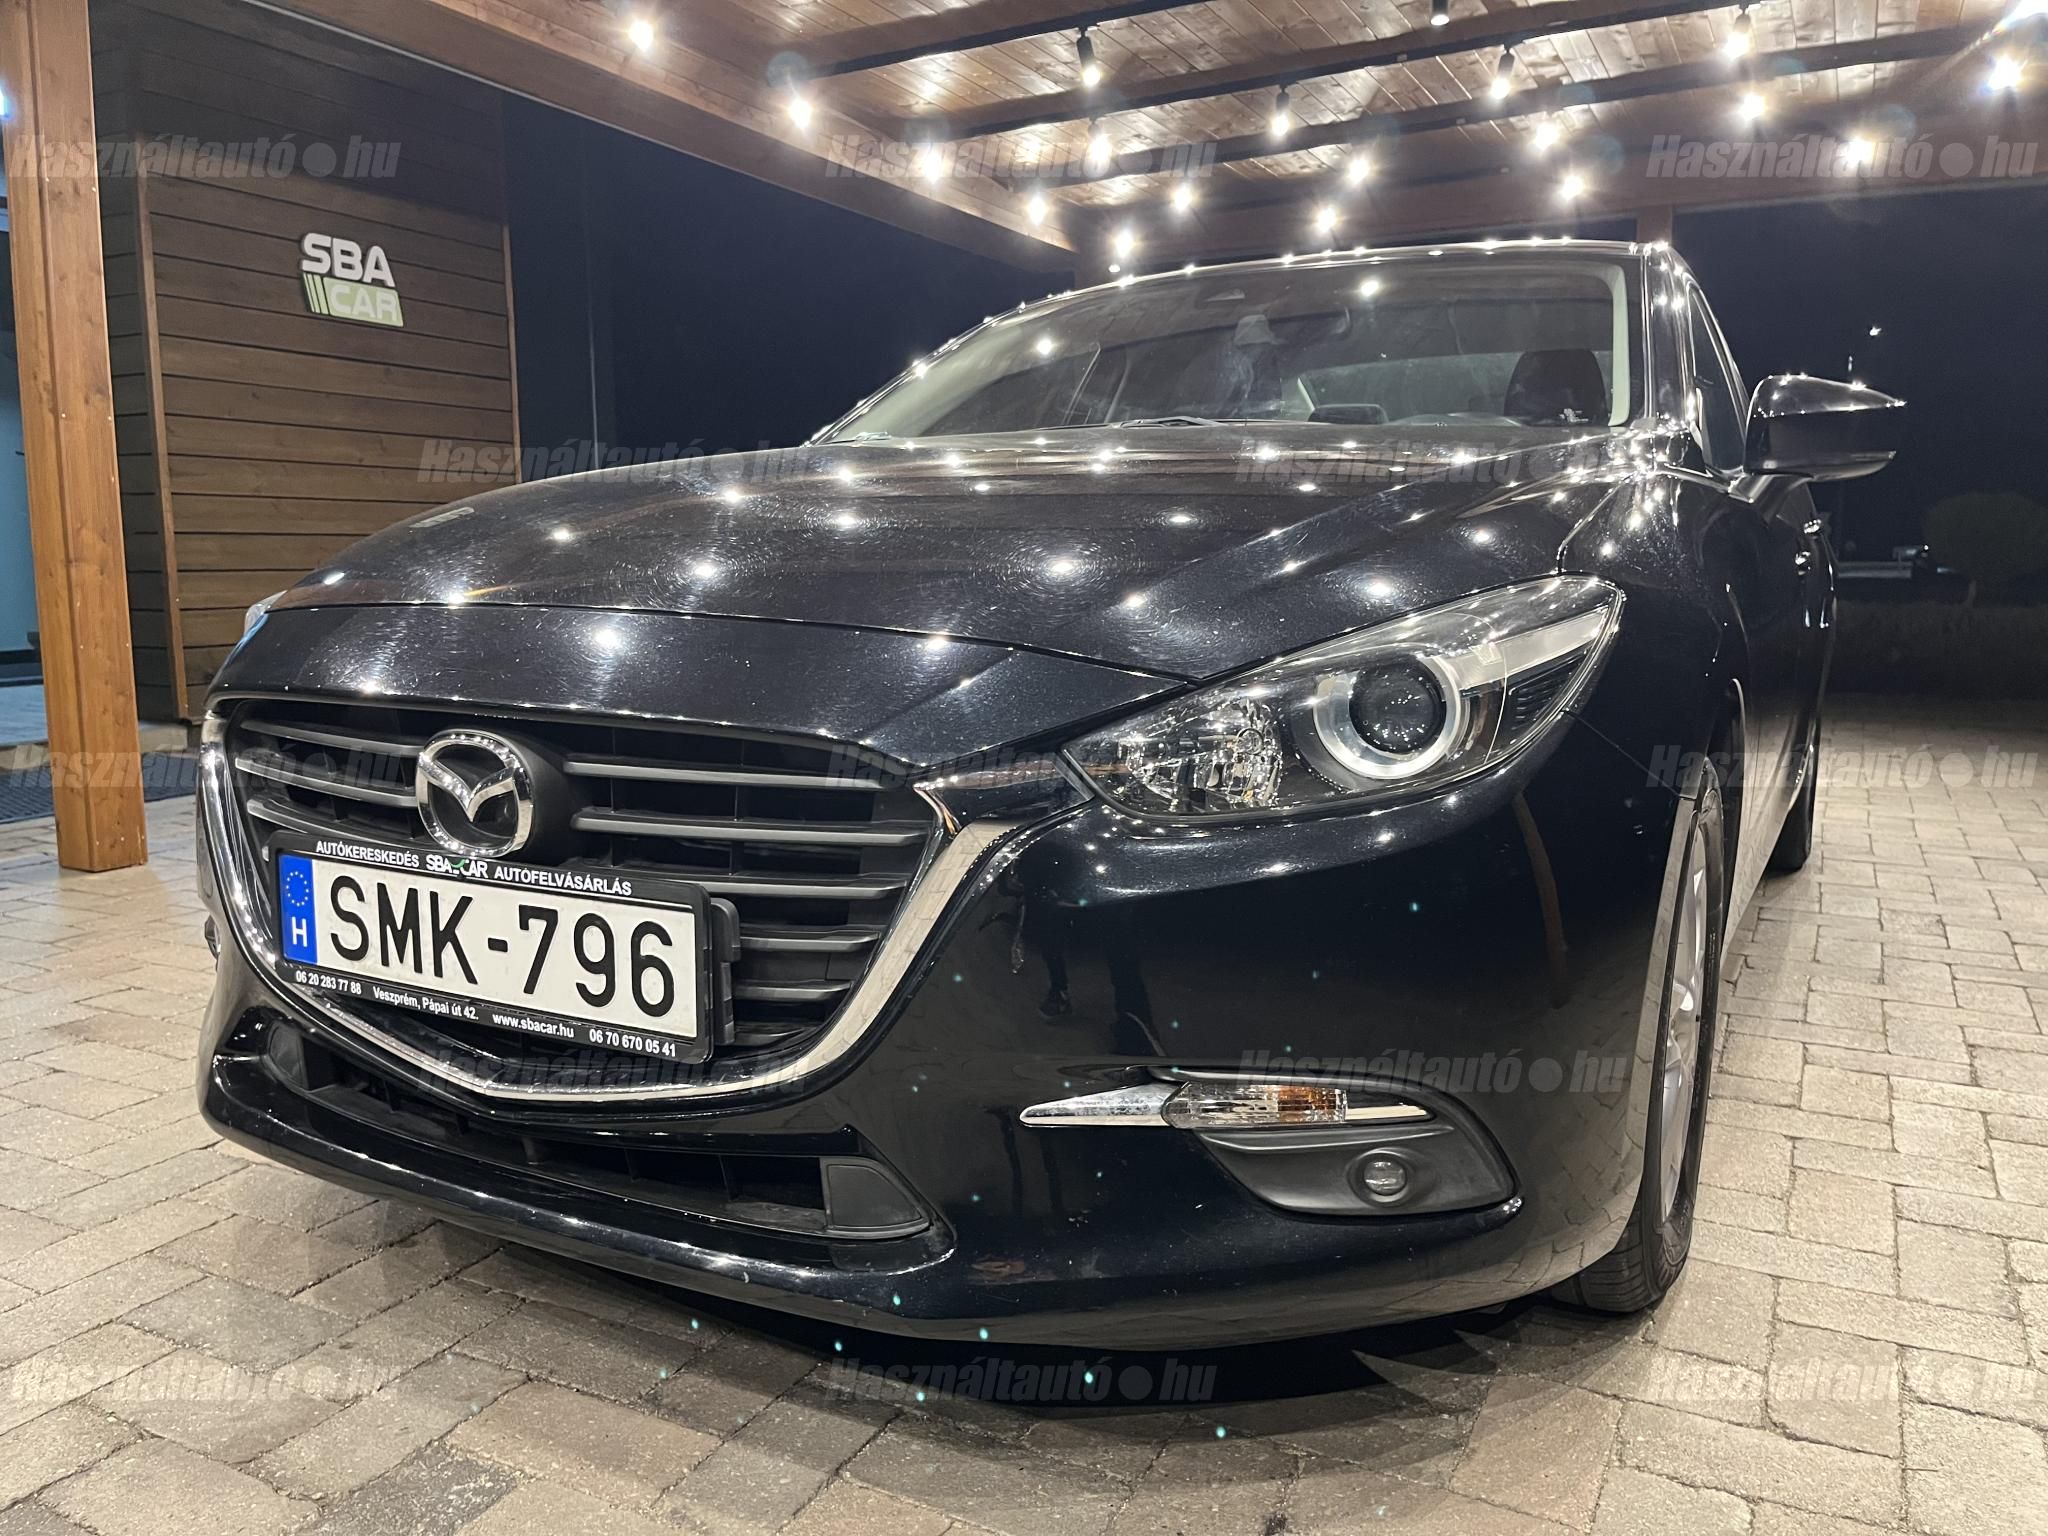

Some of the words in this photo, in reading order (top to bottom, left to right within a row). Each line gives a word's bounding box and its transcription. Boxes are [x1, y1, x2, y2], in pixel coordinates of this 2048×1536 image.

[302, 233, 395, 287] SBA
[331, 285, 398, 322] CAR
[316, 840, 419, 867] AUTÓKERESKEDÉS
[494, 866, 632, 896] AUTÓFELVÁSÁRLÁS
[292, 917, 308, 948] H
[329, 875, 675, 1018] SMK-796
[295, 970, 307, 984] 06
[308, 973, 319, 986] 20
[320, 975, 336, 989] 283
[338, 978, 349, 992] 77
[350, 981, 362, 995] 88
[373, 986, 421, 1010] Veszprém,
[422, 999, 450, 1015] Pápai
[451, 1005, 462, 1017] út
[463, 1006, 479, 1020] 42.
[492, 1013, 574, 1038] www.sbacar.hu
[589, 1028, 603, 1043] 06
[606, 1032, 620, 1046] 70
[622, 1034, 643, 1051] 670
[645, 1039, 659, 1053] 05
[662, 1042, 676, 1057] 41
